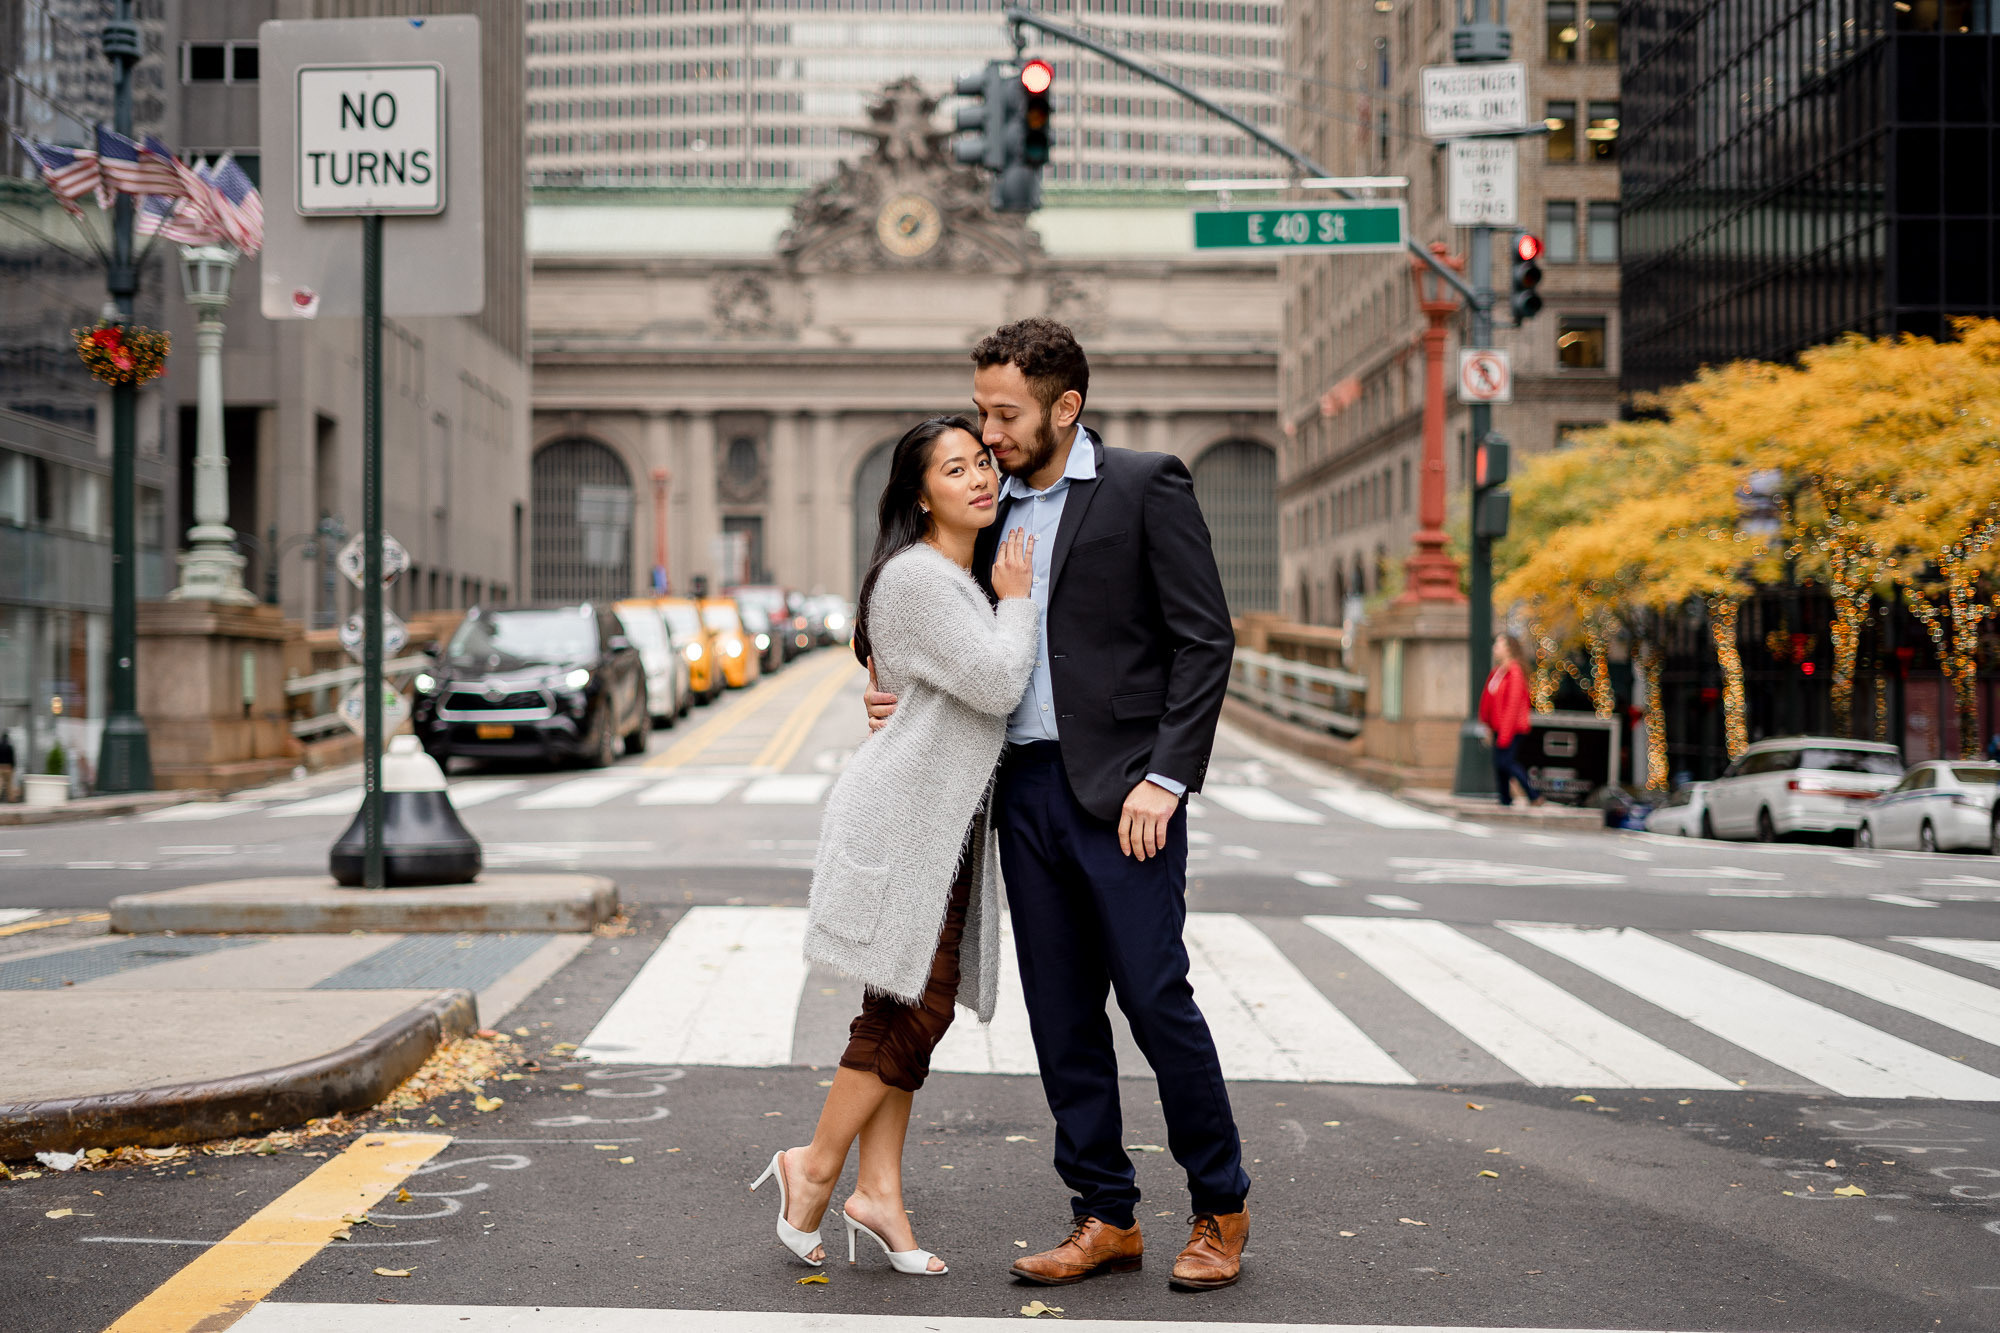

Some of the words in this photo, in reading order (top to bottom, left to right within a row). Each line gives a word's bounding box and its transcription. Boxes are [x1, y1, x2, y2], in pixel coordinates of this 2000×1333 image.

[340, 91, 397, 129] NO
[307, 151, 431, 185] TURNS
[1247, 214, 1266, 244] E
[1272, 212, 1310, 243] 40
[1317, 212, 1347, 242] St
